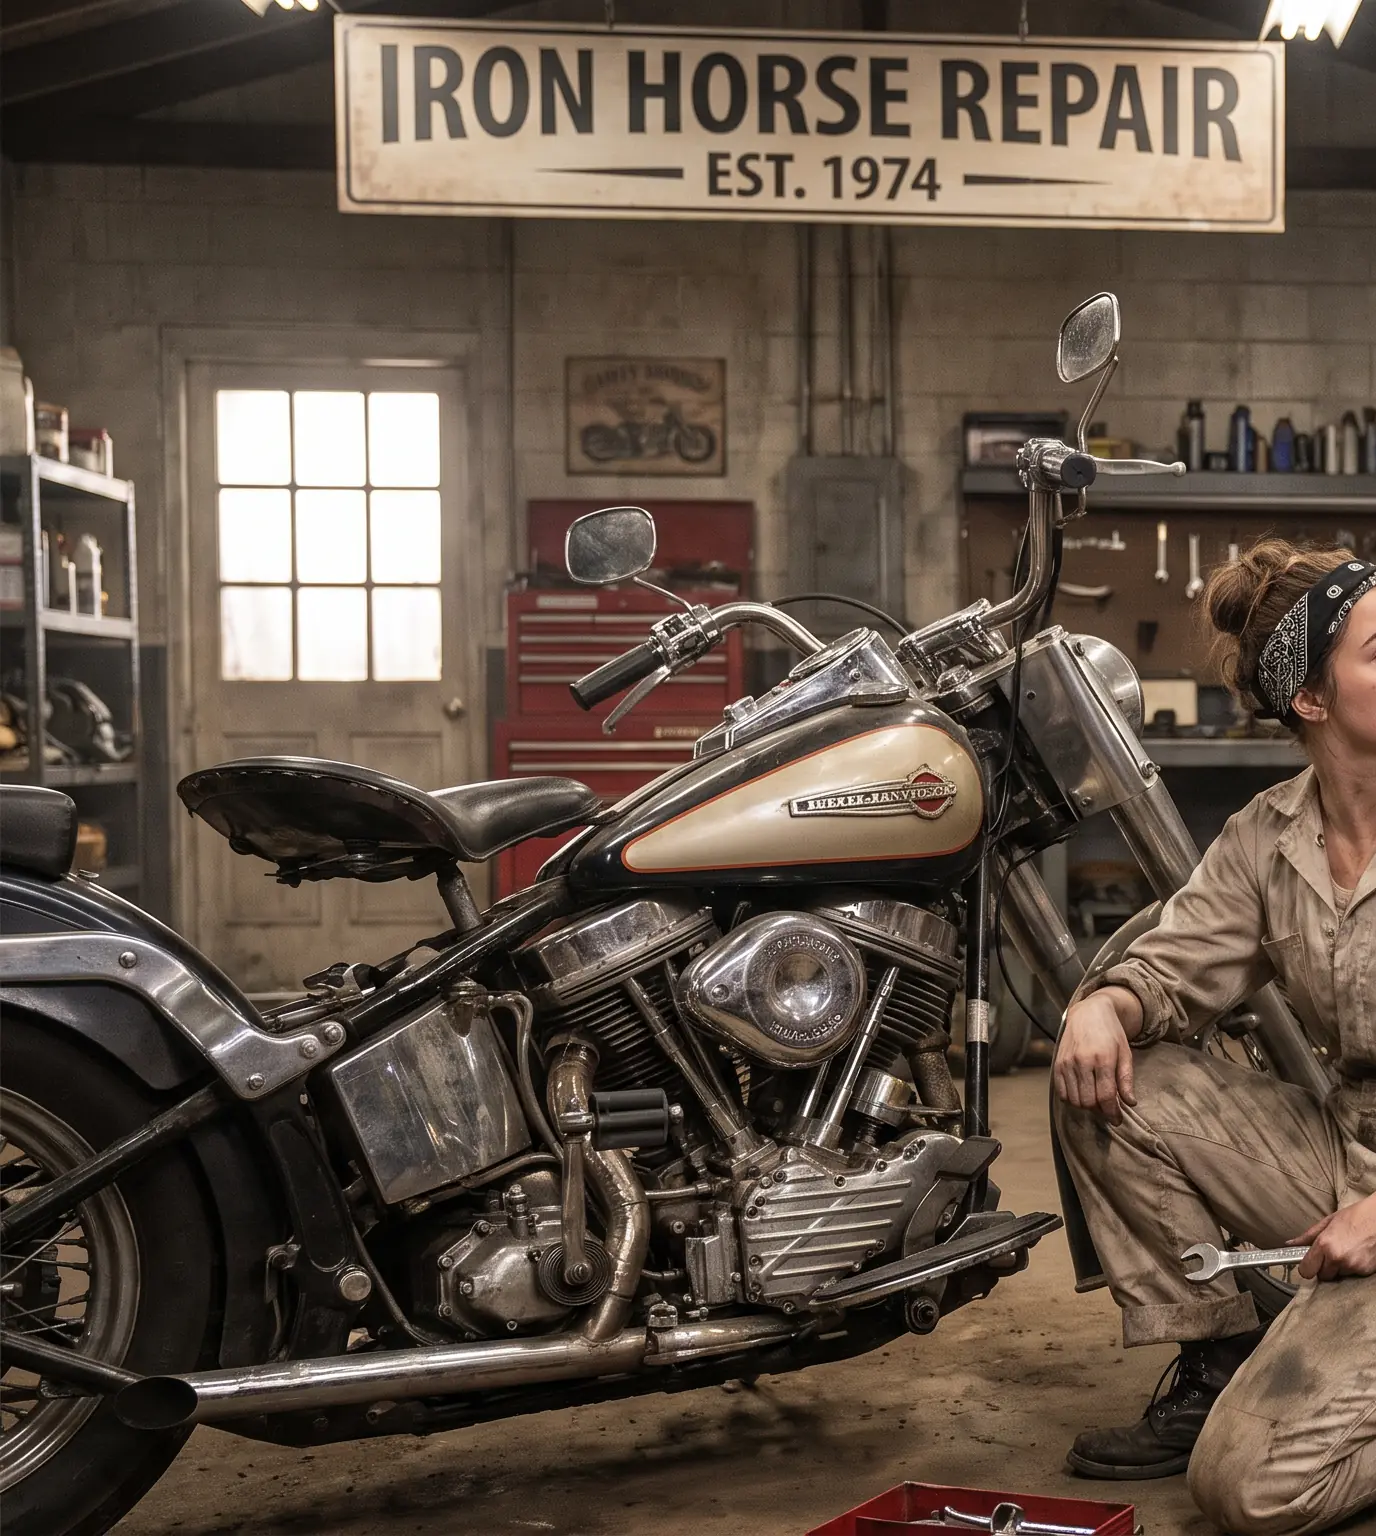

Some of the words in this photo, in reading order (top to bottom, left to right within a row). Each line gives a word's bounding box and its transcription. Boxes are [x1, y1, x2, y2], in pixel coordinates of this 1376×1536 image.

[380, 44, 594, 144] IRON
[627, 49, 912, 139] HORSE
[940, 58, 1243, 163] REPAIR
[707, 151, 806, 199] EST.
[823, 155, 941, 201] 1974
